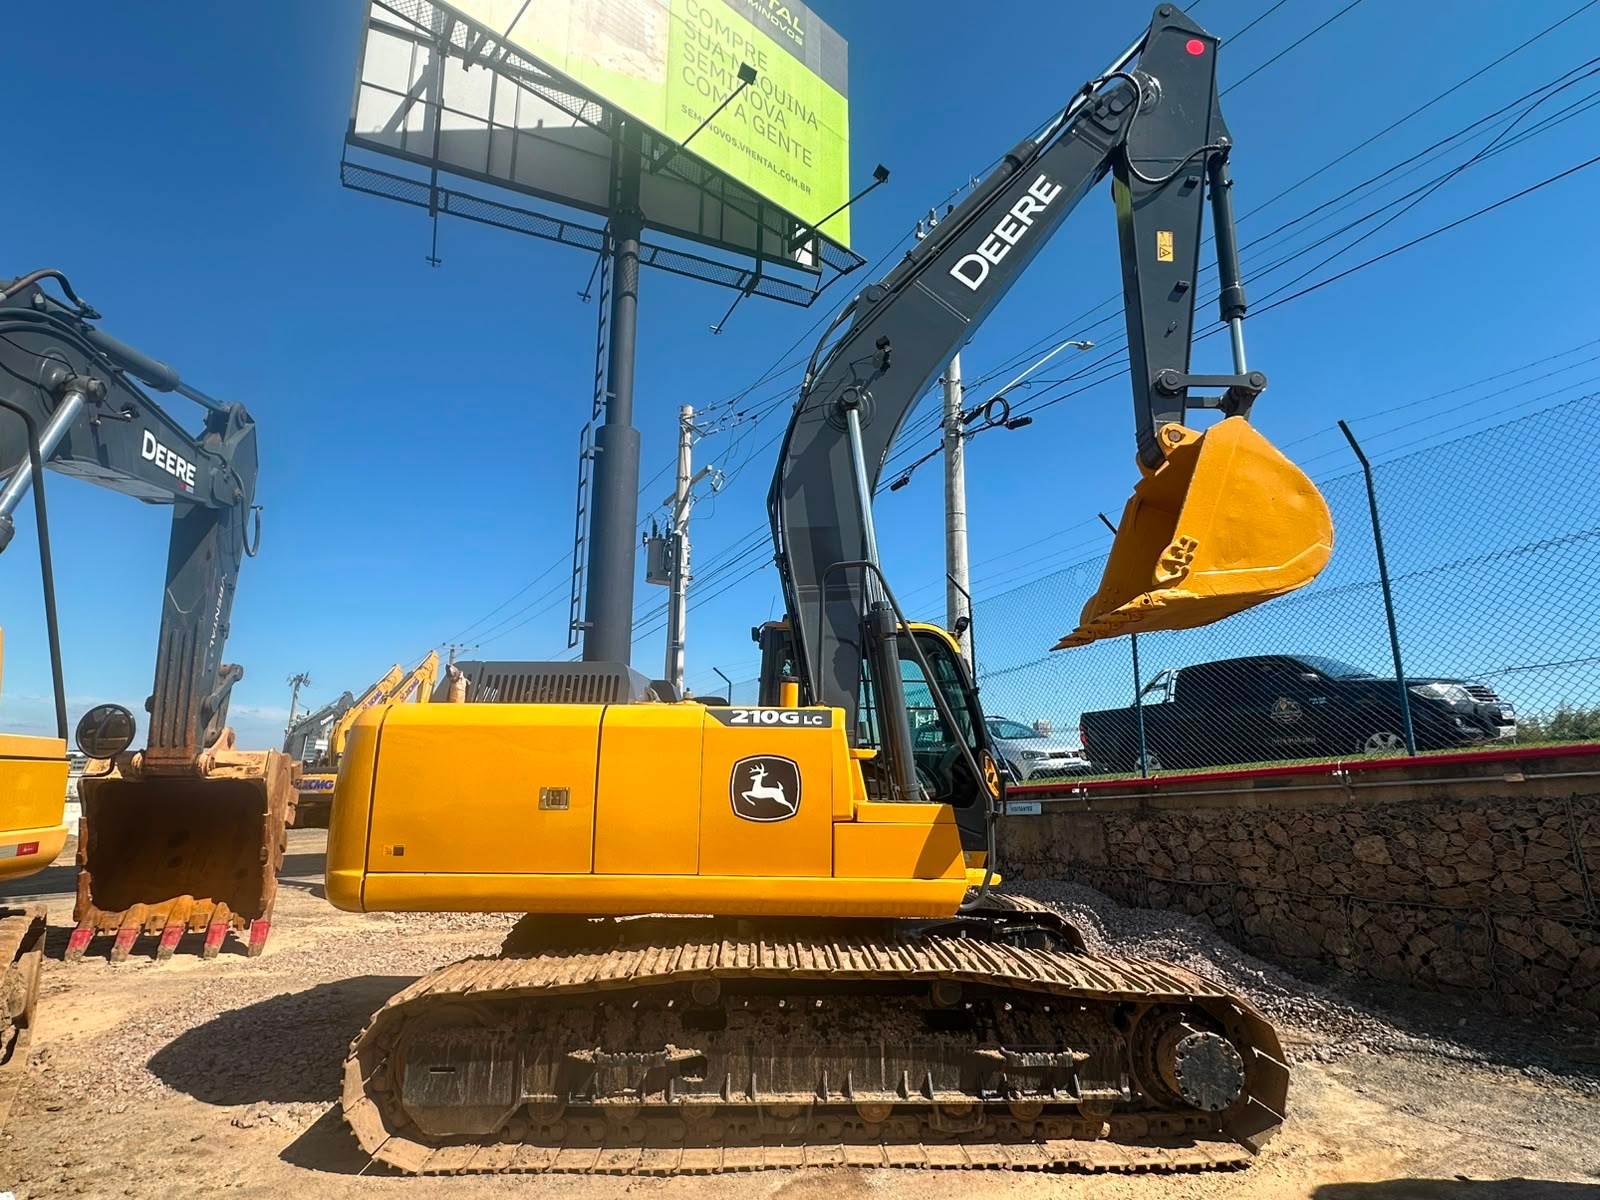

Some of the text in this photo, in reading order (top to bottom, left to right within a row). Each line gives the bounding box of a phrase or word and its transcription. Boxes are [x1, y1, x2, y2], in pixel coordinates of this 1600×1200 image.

[686, 0, 768, 72] COMPRE
[760, 0, 804, 35] TAL
[683, 42, 787, 130] SEMINOVA
[684, 19, 818, 131] SUA MQUINA
[682, 66, 812, 168] COM A GENTE
[949, 173, 1063, 291] DEERE
[141, 429, 197, 487] DEERE
[730, 710, 823, 725] 210G LC
